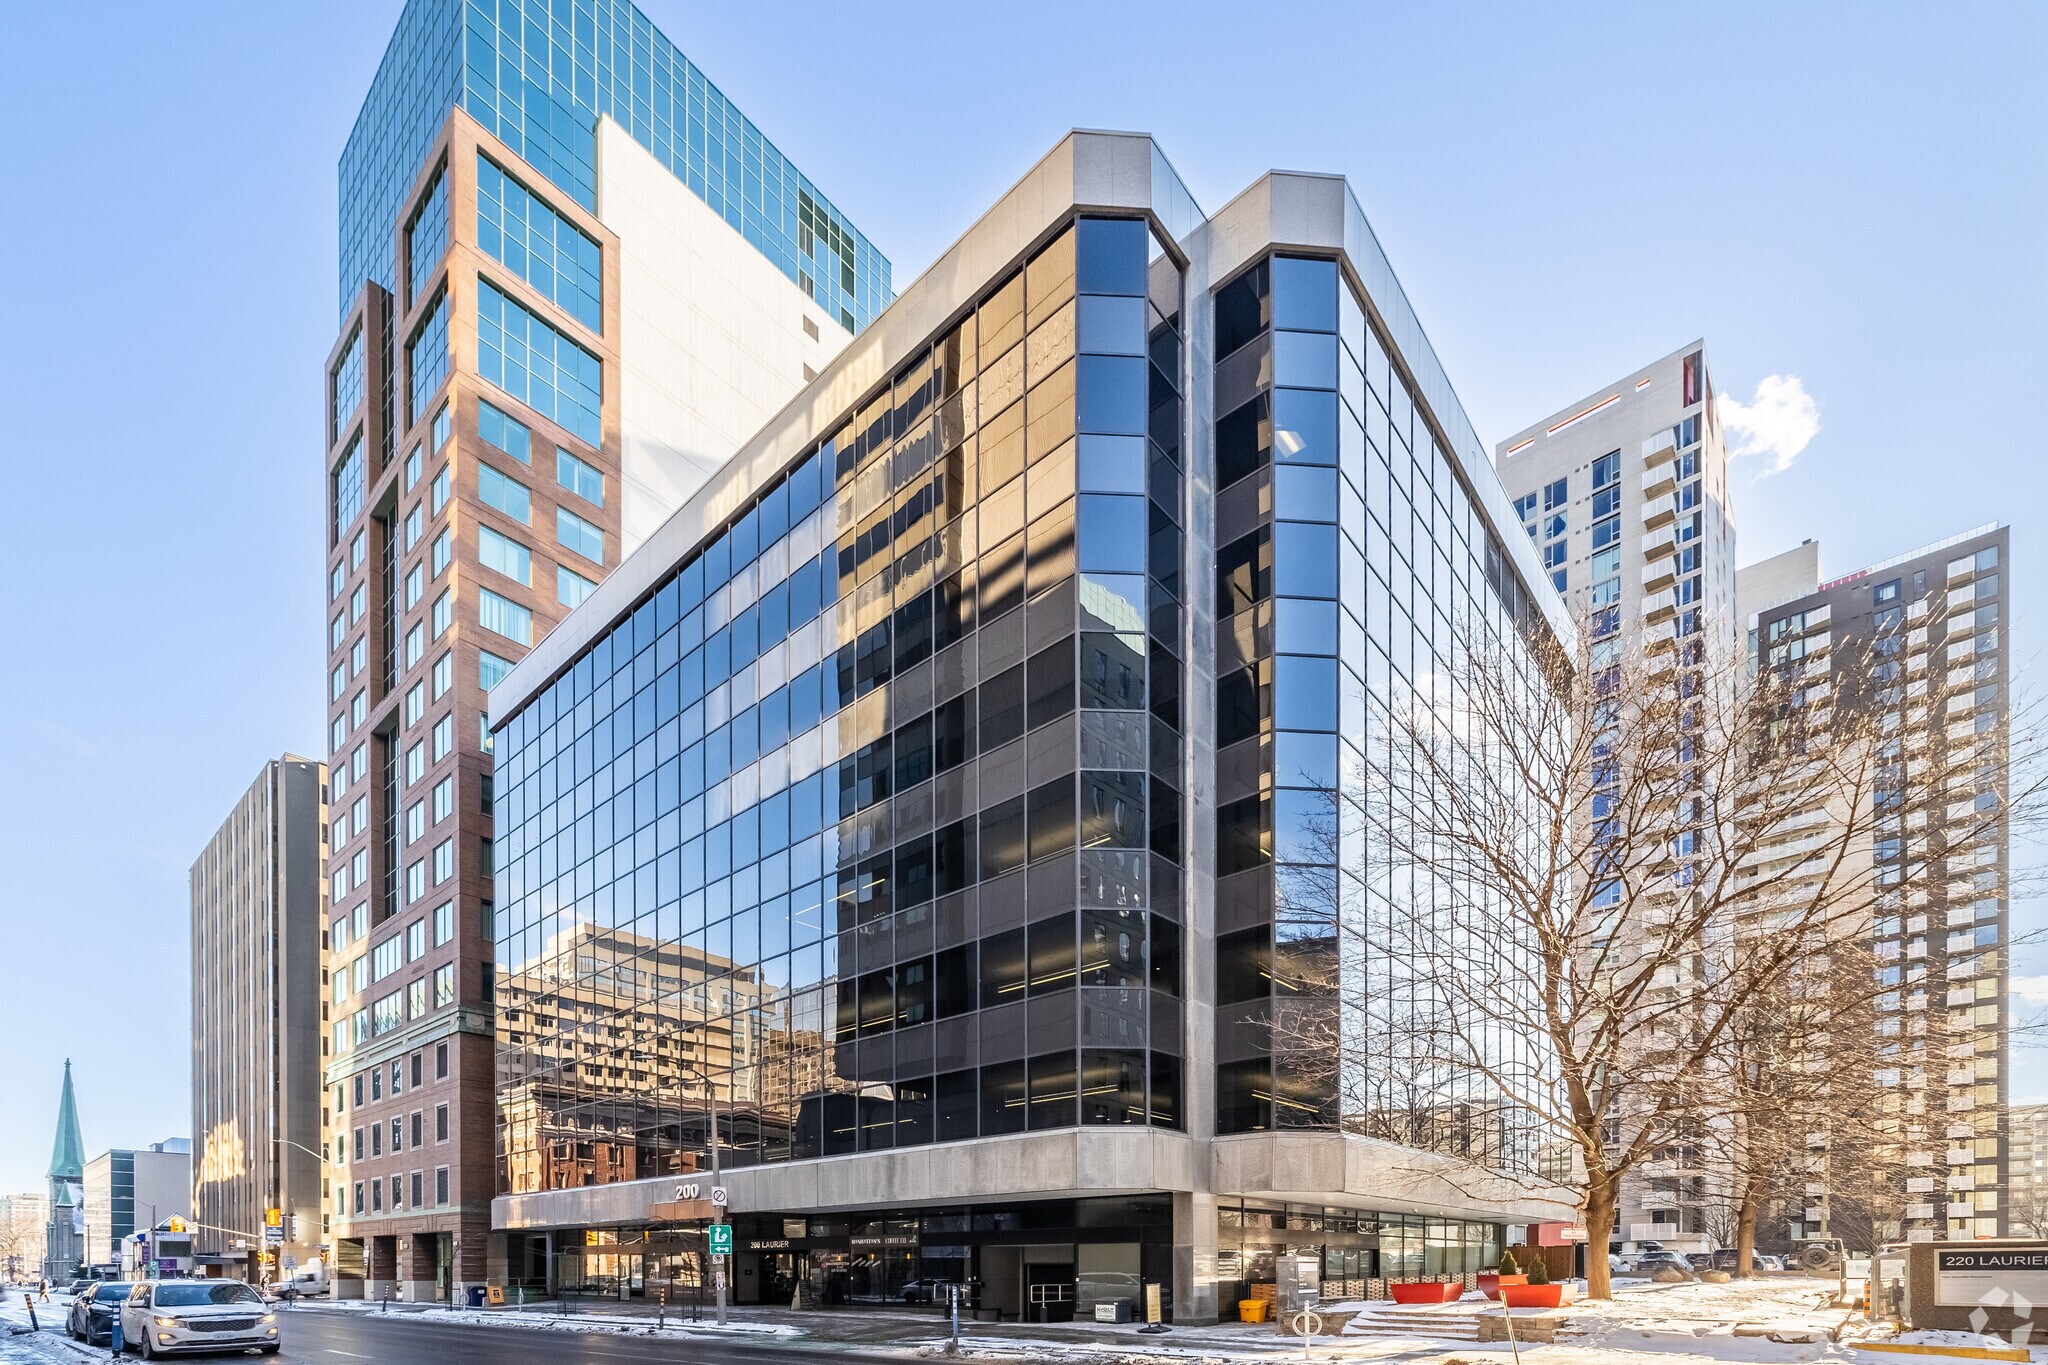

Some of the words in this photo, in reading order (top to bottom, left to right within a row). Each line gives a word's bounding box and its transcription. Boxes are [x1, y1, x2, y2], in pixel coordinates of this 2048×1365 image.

[675, 1183, 700, 1200] 200
[750, 1241, 761, 1249] 200
[761, 1240, 789, 1249] LAURIER
[1946, 1256, 1975, 1266] 220
